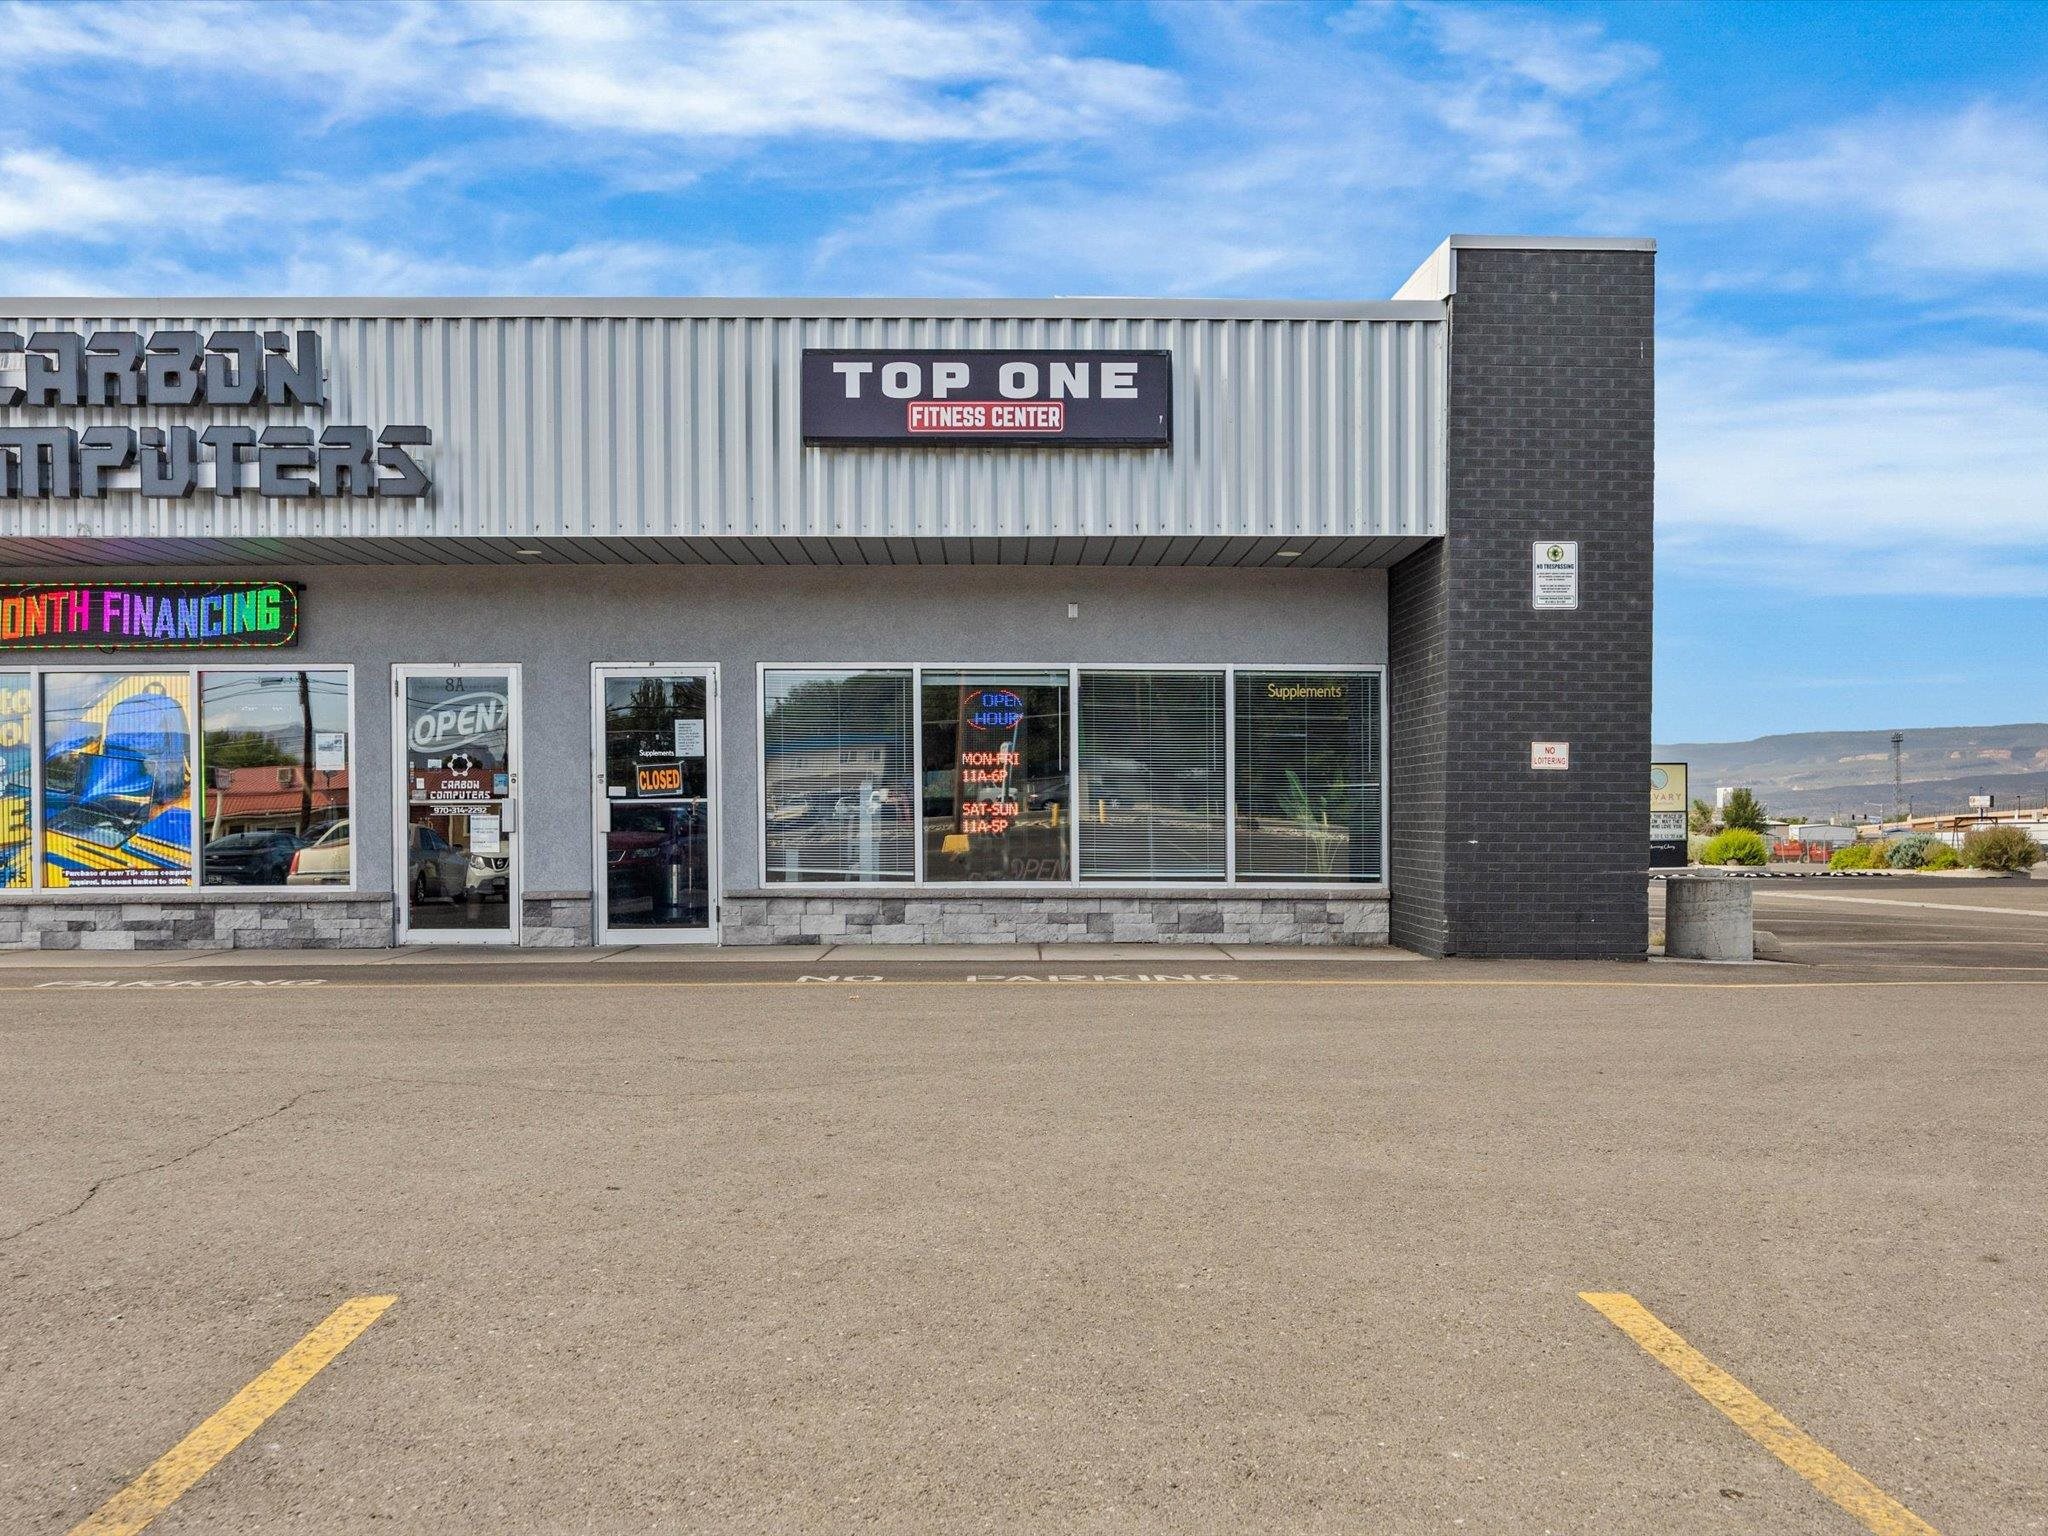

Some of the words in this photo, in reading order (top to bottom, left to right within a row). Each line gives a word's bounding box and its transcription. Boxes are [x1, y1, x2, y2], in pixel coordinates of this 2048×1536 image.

[833, 361, 970, 399] TOP
[998, 361, 1138, 399] ONE
[911, 406, 986, 428] FITNESS
[991, 406, 1060, 428] CENTER
[102, 588, 281, 640] FINANCING
[445, 677, 465, 692] 8A
[1267, 683, 1342, 700] Supplements
[982, 694, 1024, 707] OPEN
[414, 699, 498, 745] OPEN
[638, 749, 675, 757] Supplements
[1544, 746, 1556, 755] NO
[962, 752, 1020, 765] MON-FRI
[1533, 756, 1566, 765] LOITERING
[639, 768, 680, 791] CLOSED
[962, 769, 1009, 782] 11A-6P
[441, 780, 480, 789] CARBON
[430, 790, 491, 800] COMPUTERS
[962, 802, 1019, 816] SAT-SUN
[962, 819, 1009, 833] 11A-5P
[796, 975, 885, 983] NO
[965, 973, 1240, 983] PARKING
